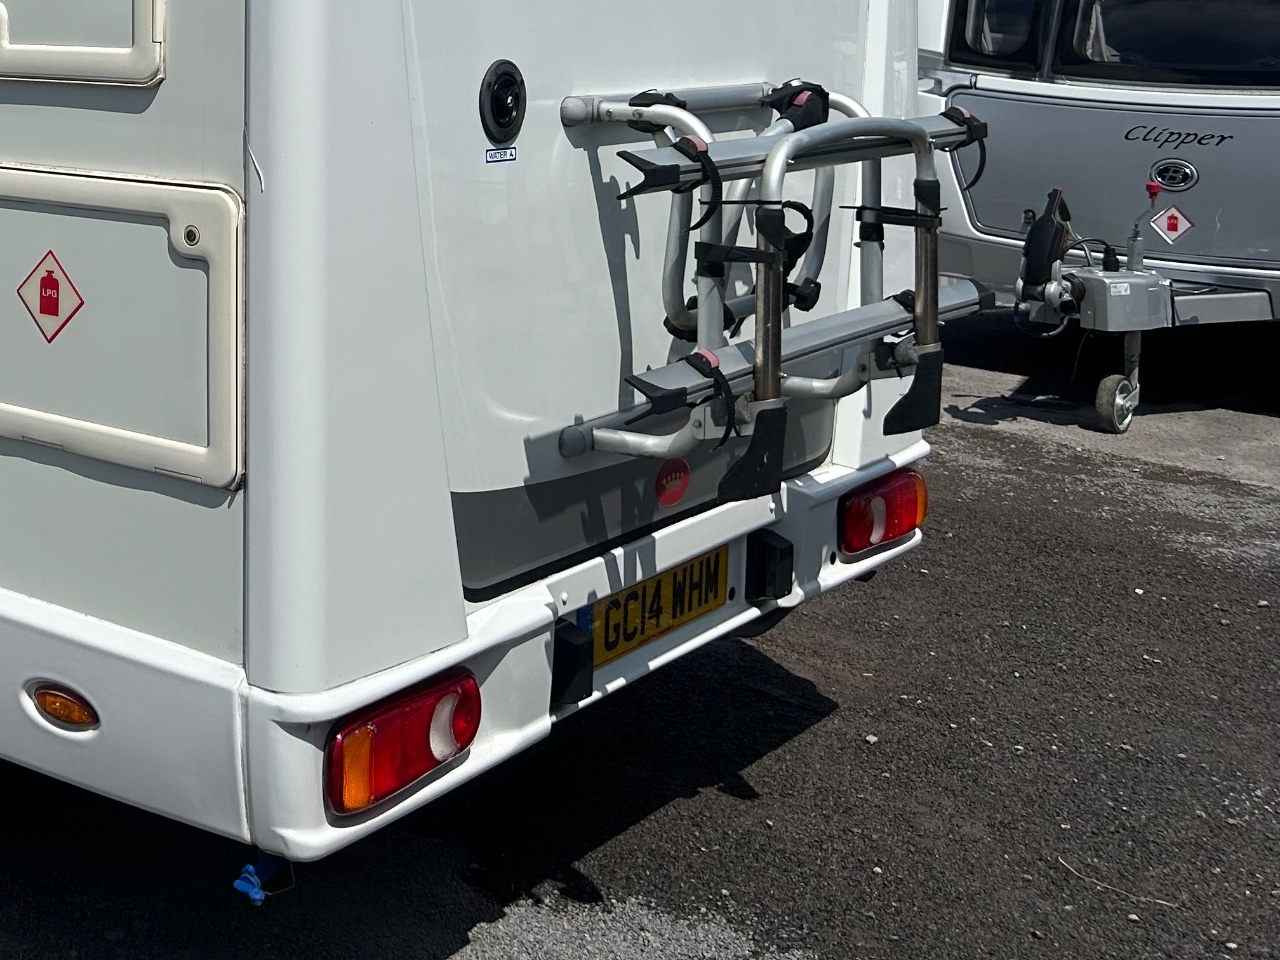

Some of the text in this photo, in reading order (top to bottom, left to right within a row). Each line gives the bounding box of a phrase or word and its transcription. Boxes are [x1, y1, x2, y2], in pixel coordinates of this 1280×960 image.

[1124, 125, 1234, 150] Clipper
[488, 150, 508, 160] WATER
[42, 287, 58, 298] LPG
[603, 552, 721, 652] GC14 WHM
